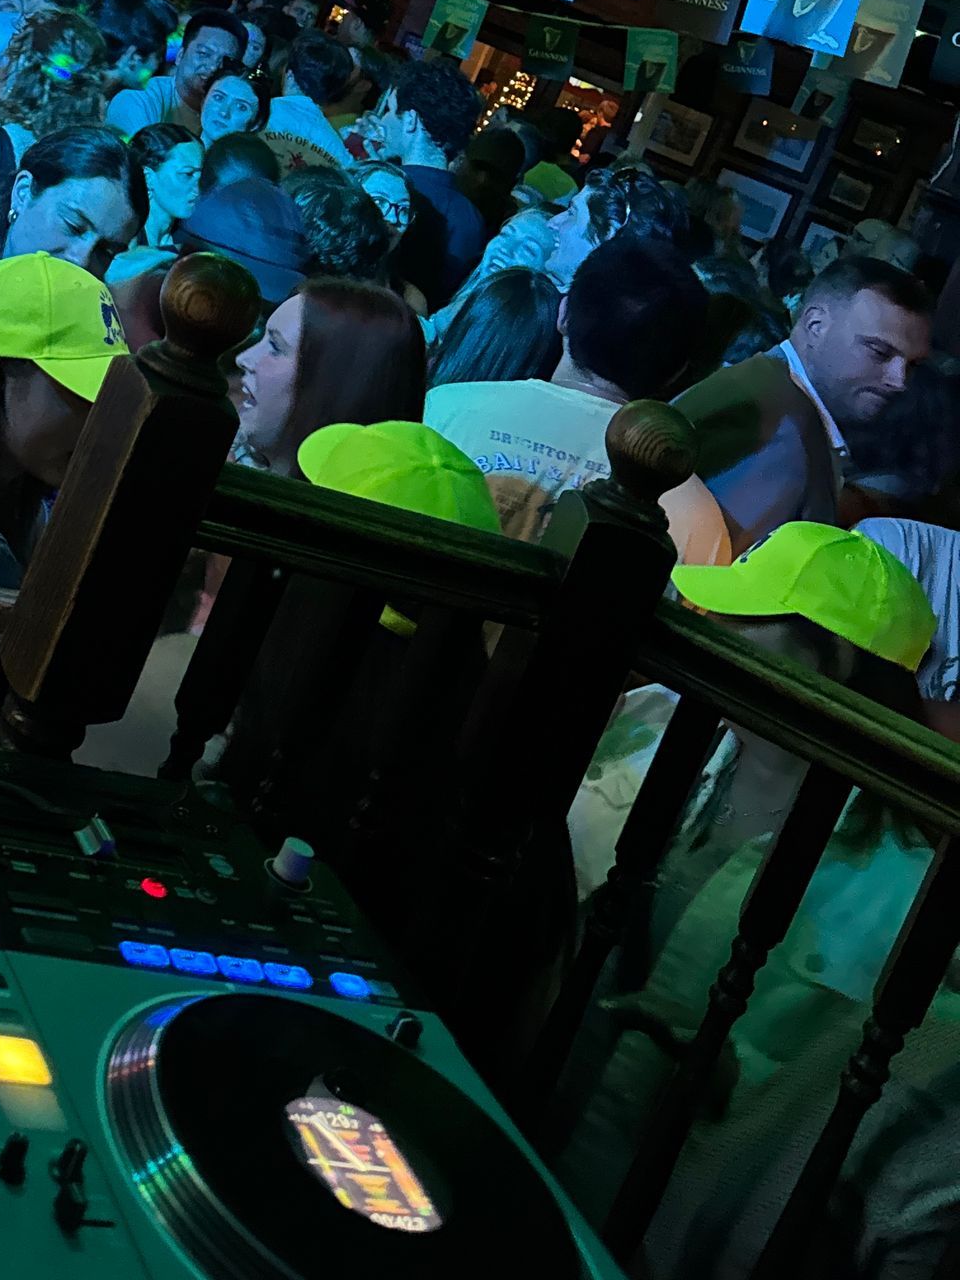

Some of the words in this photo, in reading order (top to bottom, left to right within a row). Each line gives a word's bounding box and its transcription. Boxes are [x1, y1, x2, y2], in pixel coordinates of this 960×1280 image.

[265, 131, 293, 142] KING
[295, 136, 309, 147] OF
[489, 429, 581, 464] BRIGHTON
